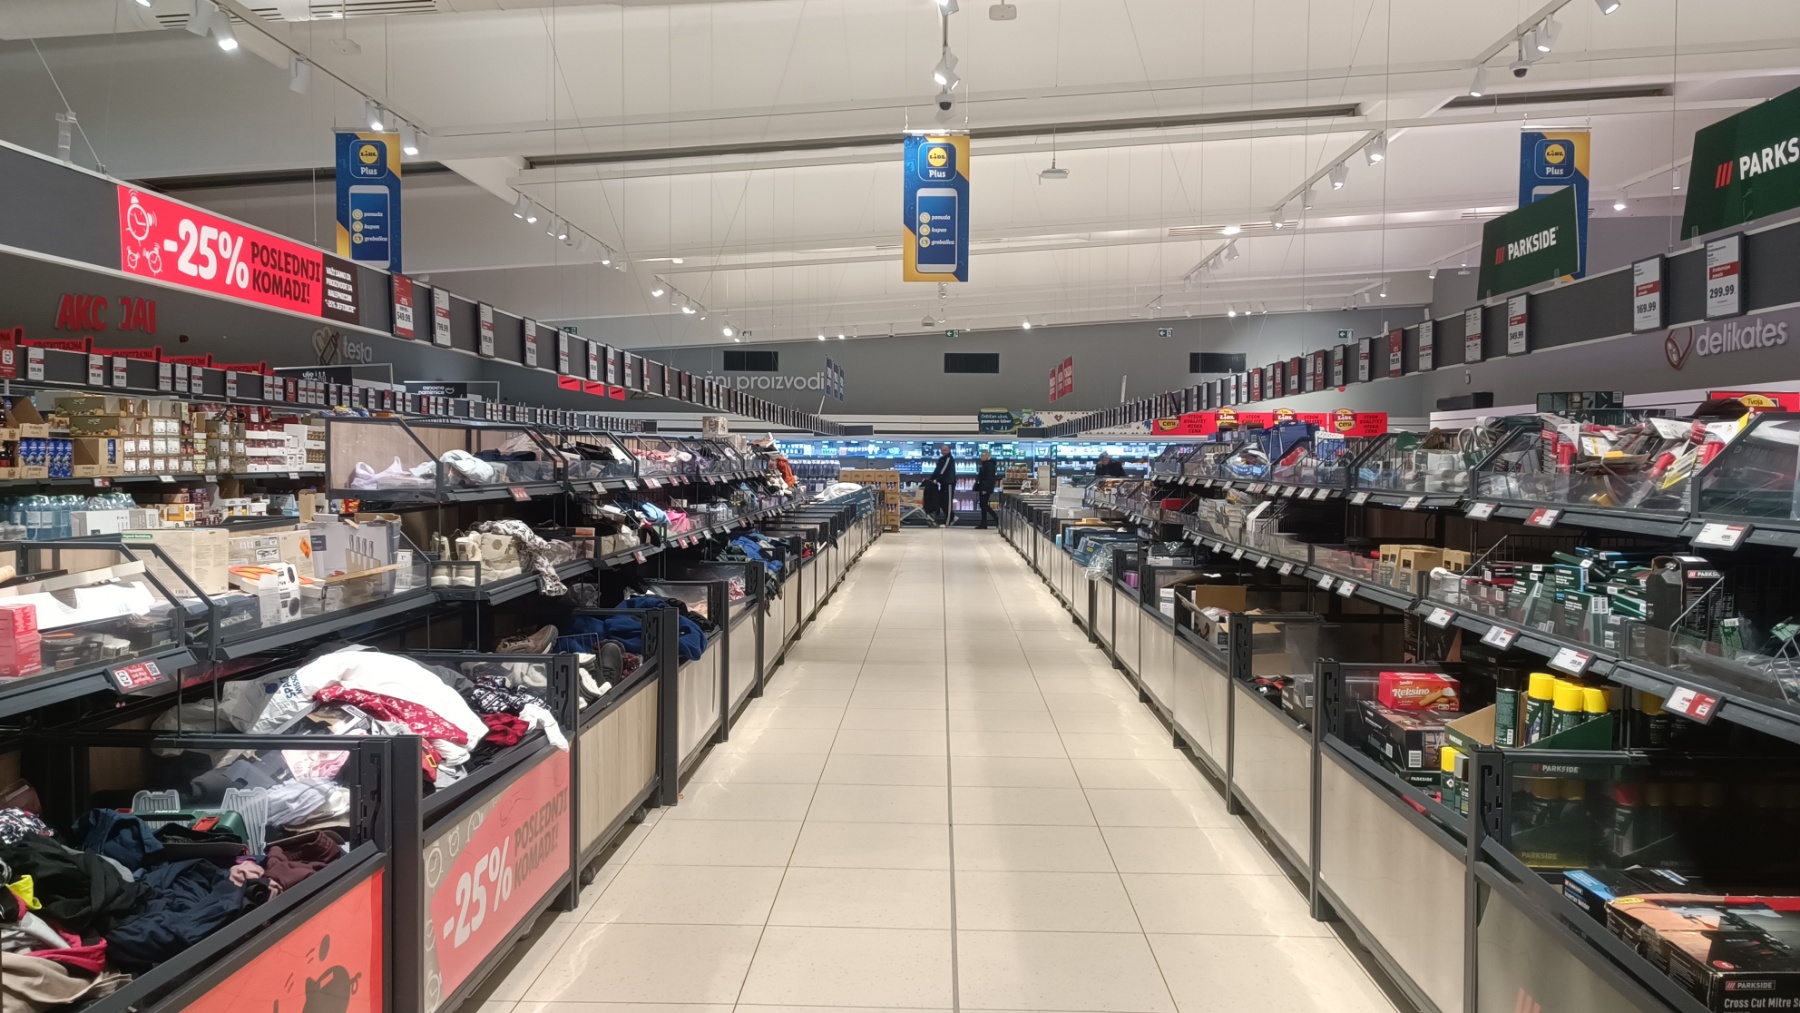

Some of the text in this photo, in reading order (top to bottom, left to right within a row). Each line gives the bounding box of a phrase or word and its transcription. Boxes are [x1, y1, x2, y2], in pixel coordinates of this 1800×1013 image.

[929, 152, 946, 160] LIDL
[1739, 137, 1800, 180] PARKS
[360, 167, 378, 175] Plus
[929, 169, 946, 178] Plus
[1546, 167, 1564, 175] Plus
[931, 214, 951, 222] ponuda
[1507, 226, 1558, 261] PARKSIDE
[163, 218, 250, 289] -25%
[250, 241, 321, 283] POSLEDNJI
[252, 268, 310, 304] KOMADI!
[1709, 284, 1735, 299] 299.99
[1637, 301, 1657, 314] 169.99
[1696, 318, 1788, 357] delikates
[736, 371, 825, 391] proizvodi
[1747, 398, 1764, 406] Tvoja
[1542, 765, 1580, 773] PARKSIDE
[514, 786, 568, 857] POSLEDNJI
[514, 822, 559, 890] KOMADI!
[1521, 852, 1558, 860] PARKSIDE
[443, 836, 513, 949] -25%
[1724, 998, 1749, 1009] Cross
[1751, 998, 1766, 1008] Cut
[1768, 997, 1792, 1008] Mitre
